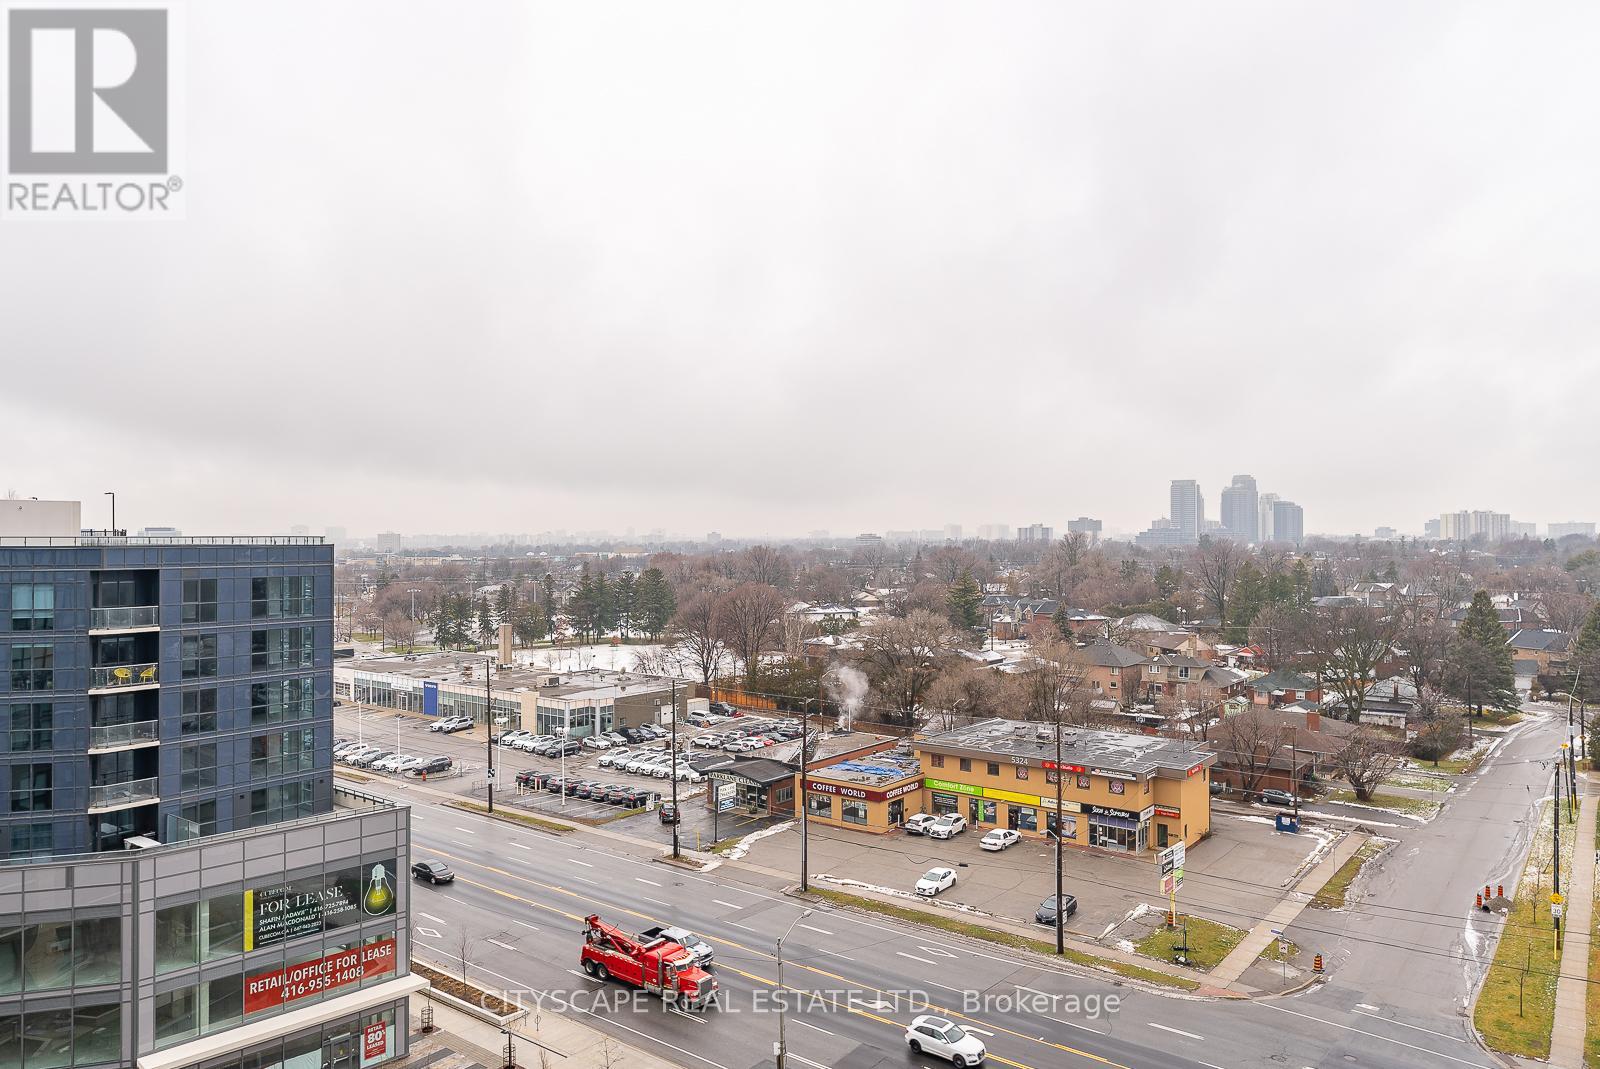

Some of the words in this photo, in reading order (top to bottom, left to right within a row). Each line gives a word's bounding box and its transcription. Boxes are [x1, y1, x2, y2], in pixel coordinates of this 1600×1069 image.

[1011, 756, 1028, 765] 5324
[812, 783, 837, 793] COFFEE
[840, 787, 866, 798] WORLD
[886, 787, 903, 799] COFFEE
[902, 781, 919, 795] WORLD
[933, 779, 958, 790] Comfort
[959, 783, 975, 793] Zone
[260, 898, 291, 915] FOR
[296, 885, 343, 907] LEASE
[258, 923, 276, 932] ALAN
[259, 915, 281, 925] SHAFIN
[249, 959, 333, 995] RETAIL/OFFICE
[336, 954, 358, 970] FOR
[362, 943, 392, 962] LEASE
[281, 965, 365, 999] 416-955-1408
